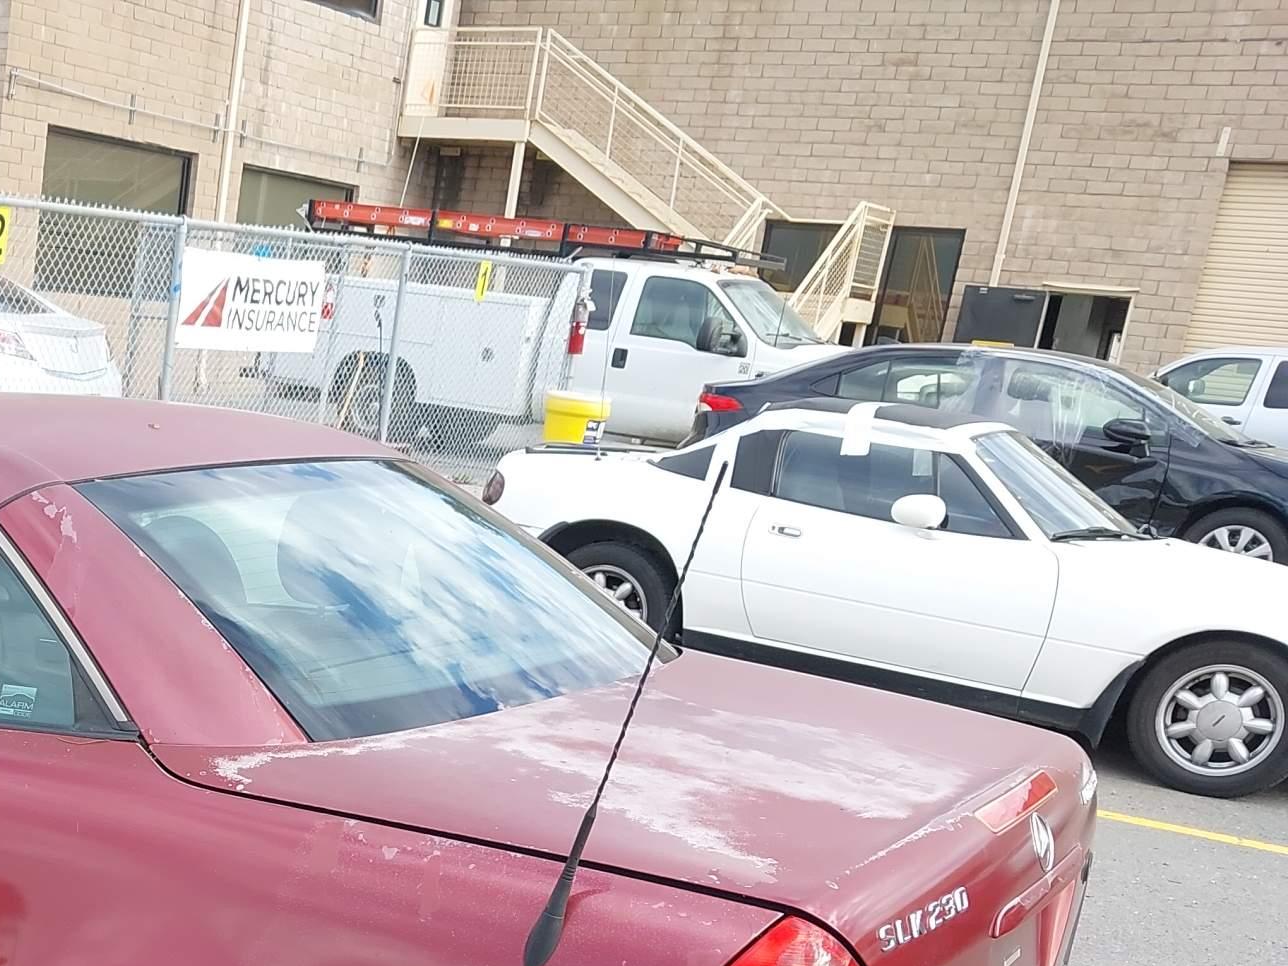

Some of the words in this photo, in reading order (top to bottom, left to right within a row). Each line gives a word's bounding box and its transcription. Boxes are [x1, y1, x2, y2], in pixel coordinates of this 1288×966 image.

[231, 276, 320, 306] MERCURY
[481, 266, 489, 297] 1
[226, 307, 317, 333] INSURANCE
[877, 910, 927, 952] SLK
[926, 886, 969, 930] 230
